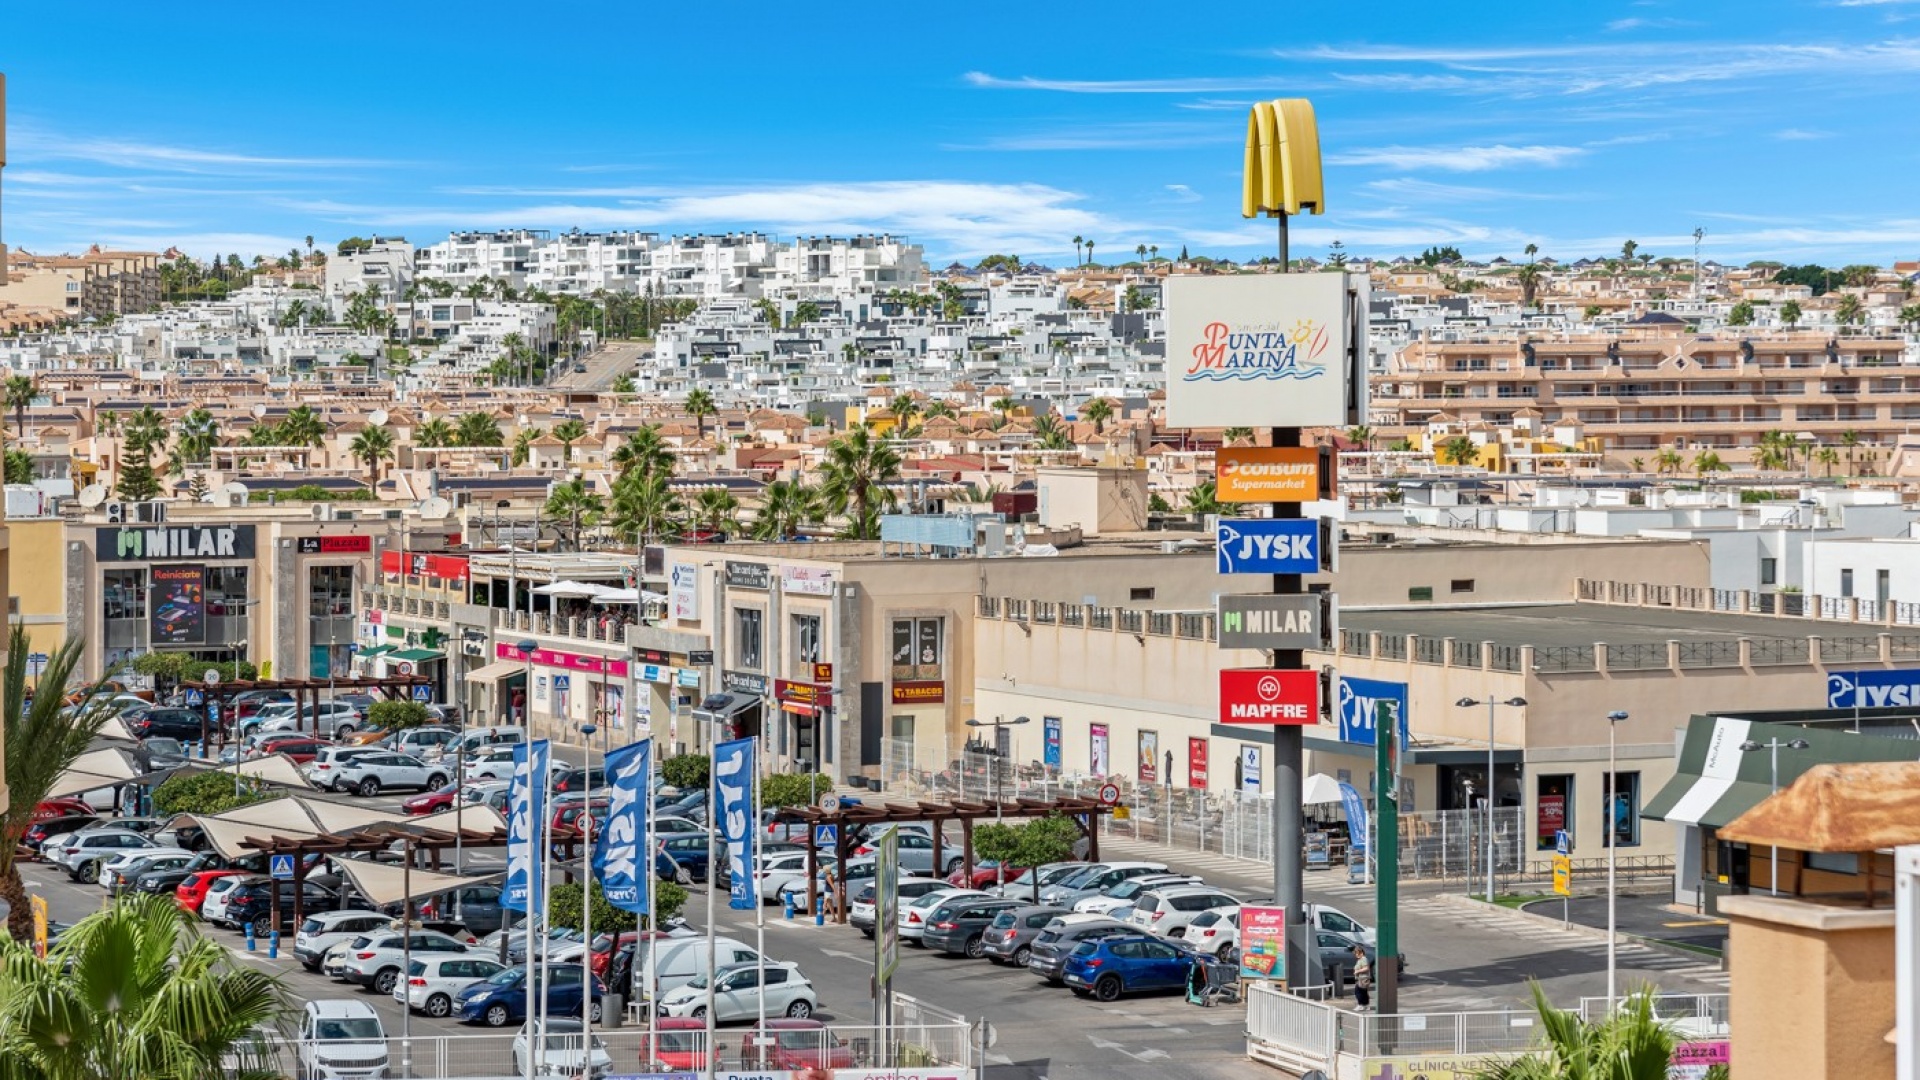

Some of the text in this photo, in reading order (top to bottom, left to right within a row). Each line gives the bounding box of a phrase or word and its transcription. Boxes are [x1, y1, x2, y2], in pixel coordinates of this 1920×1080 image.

[1204, 322, 1287, 350] PUNTA
[1187, 344, 1297, 373] MARINA
[1239, 462, 1316, 476] consum
[1231, 478, 1306, 492] Supermarket
[146, 528, 235, 557] MILAR
[303, 538, 318, 548] La
[1238, 534, 1314, 559] JYSK
[1246, 610, 1312, 633] MILAR
[905, 687, 943, 695] TABACOS
[1231, 703, 1308, 719] MAPFRE
[1709, 727, 1724, 768] McAuto
[1104, 790, 1115, 798] 20
[824, 799, 836, 807] 20
[1409, 1057, 1457, 1072] CLÍNICA
